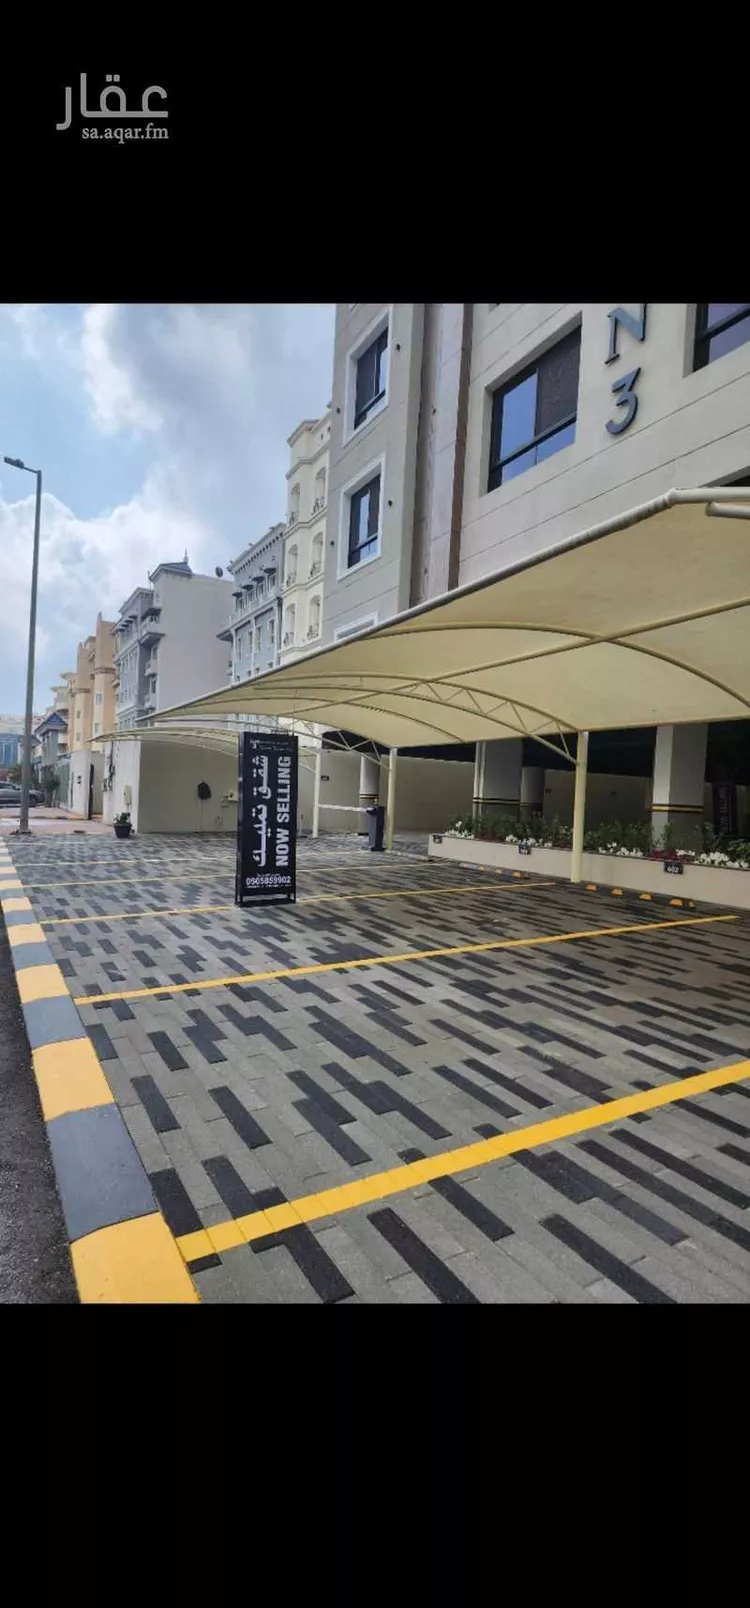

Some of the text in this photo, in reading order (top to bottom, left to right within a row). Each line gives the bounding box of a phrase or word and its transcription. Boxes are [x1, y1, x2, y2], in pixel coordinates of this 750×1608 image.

[252, 755, 272, 799] شقق
[252, 804, 271, 867] تمليك
[276, 756, 291, 867] NOW SELLING
